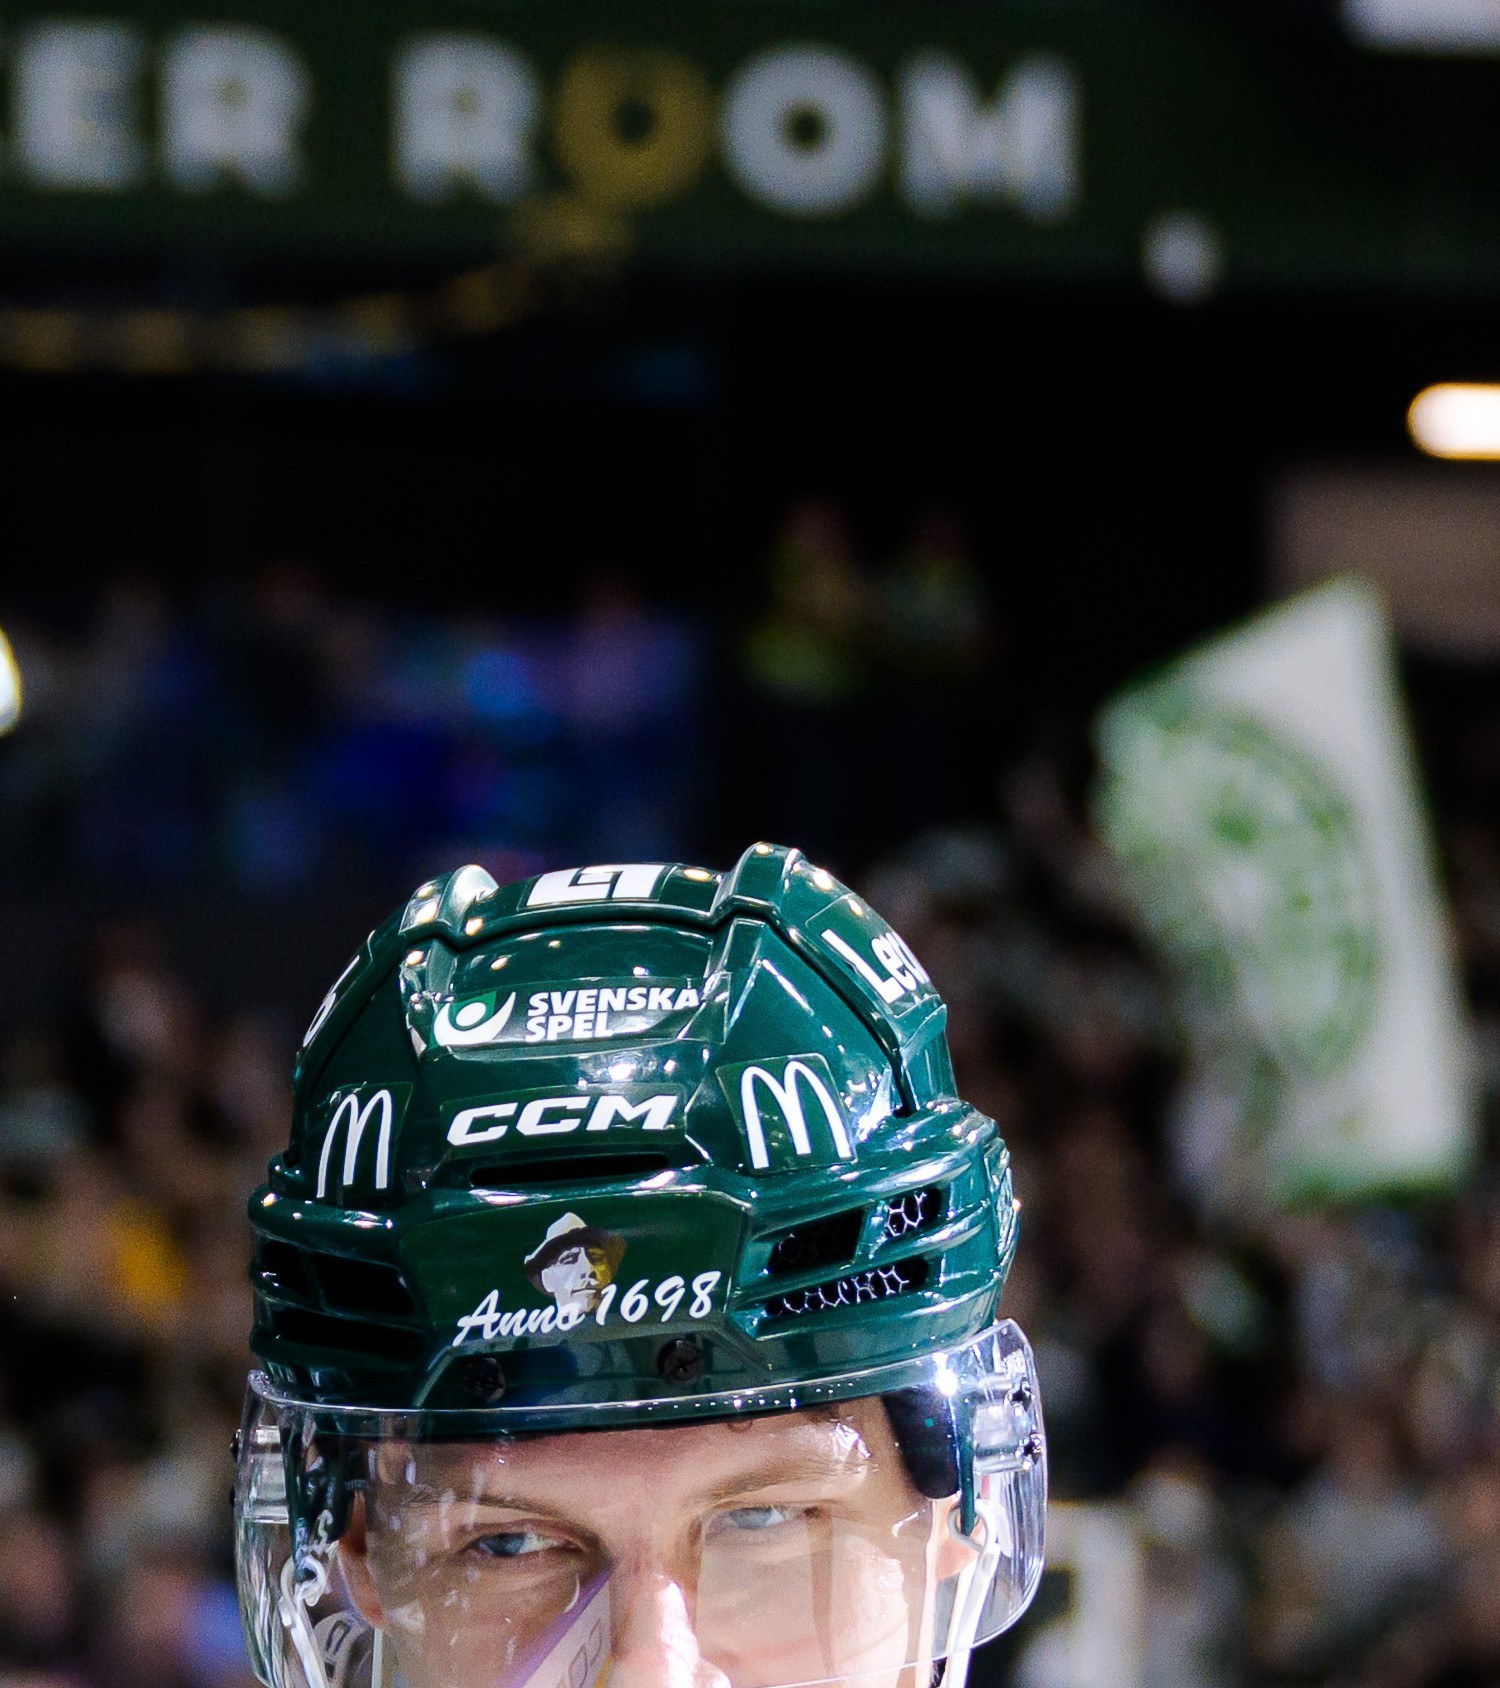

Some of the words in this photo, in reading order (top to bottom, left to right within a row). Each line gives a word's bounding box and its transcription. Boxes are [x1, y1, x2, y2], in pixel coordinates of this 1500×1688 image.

[392, 30, 1083, 220] ROOM
[525, 1013, 614, 1041] SPEL
[528, 986, 700, 1018] SVENSKA
[447, 1094, 678, 1147] CCM
[453, 1289, 586, 1348] Anno
[598, 1270, 722, 1327] 1698
